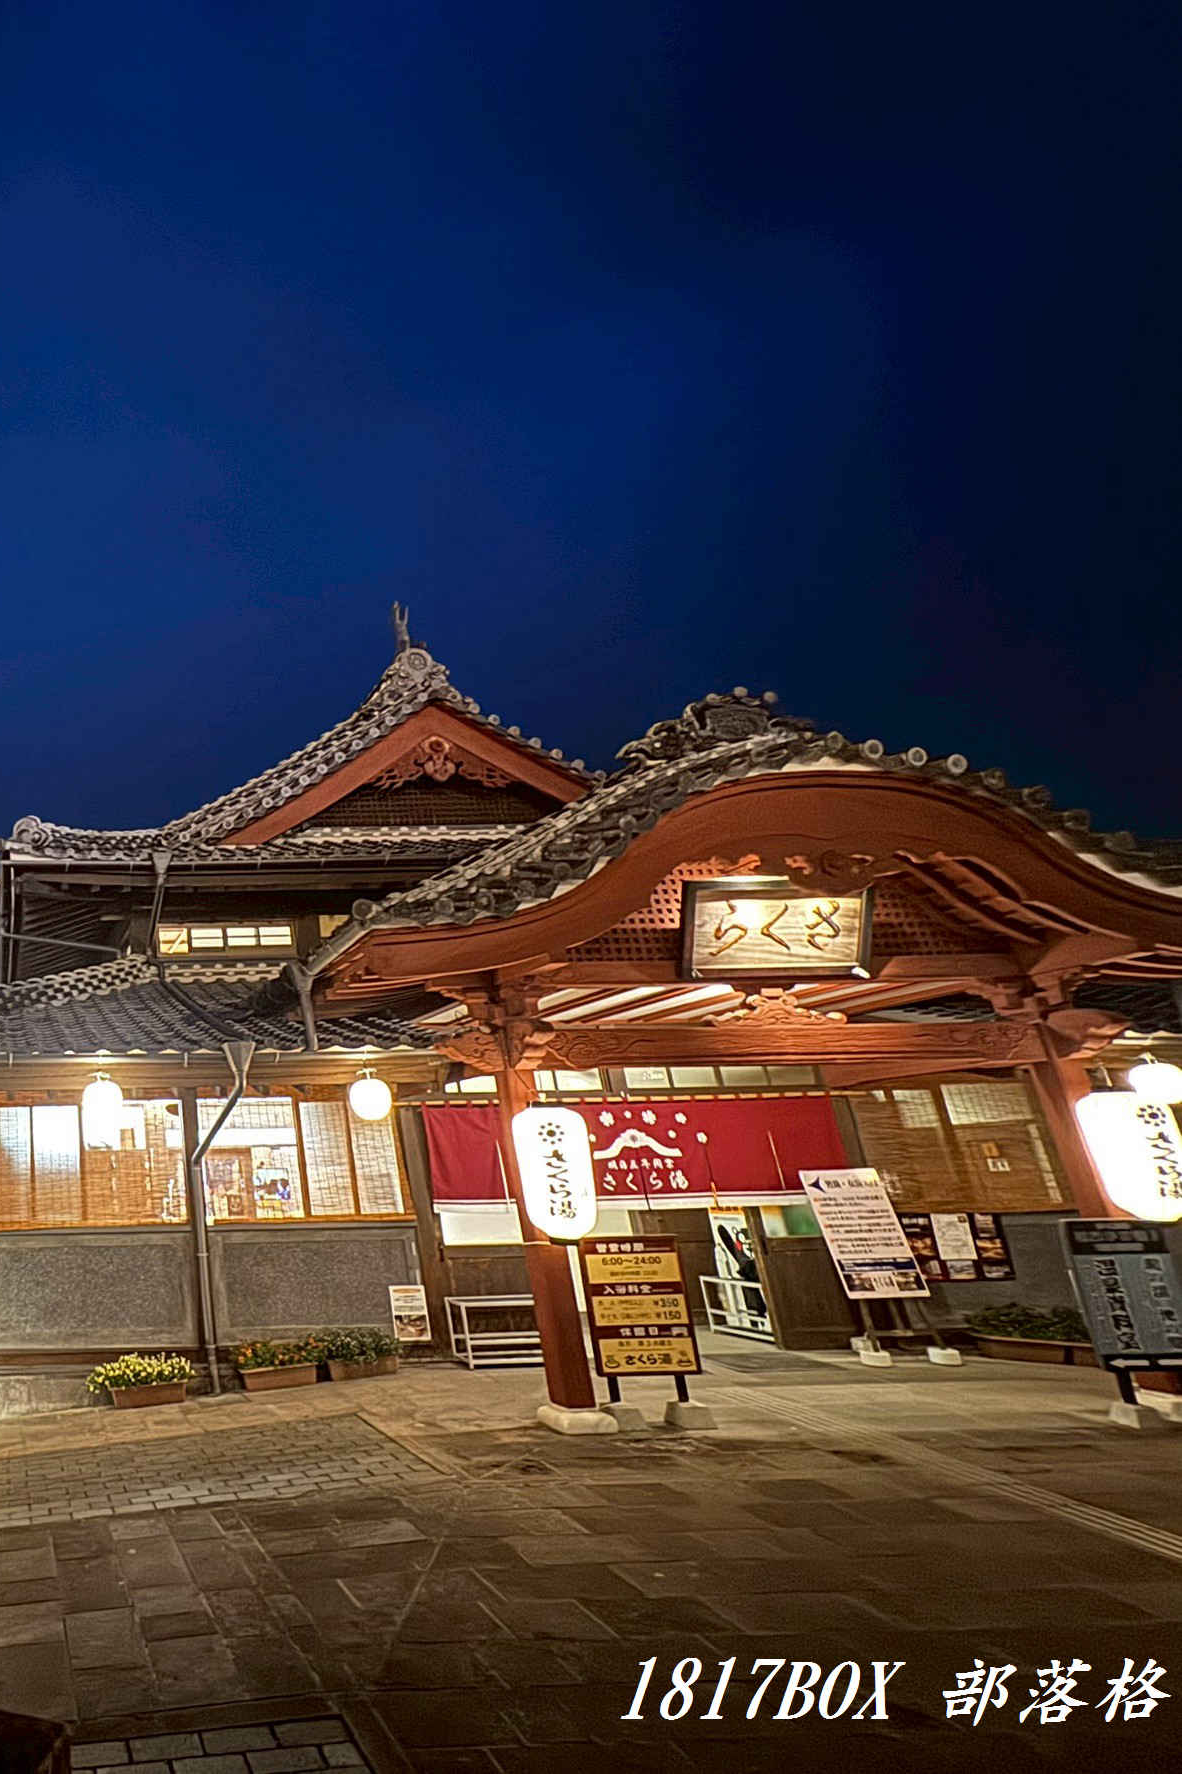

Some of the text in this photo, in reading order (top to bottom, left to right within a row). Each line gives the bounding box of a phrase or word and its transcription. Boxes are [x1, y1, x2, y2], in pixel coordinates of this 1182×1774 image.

[543, 1149, 576, 1219] さくら湯
[603, 1169, 689, 1191] さくら湯
